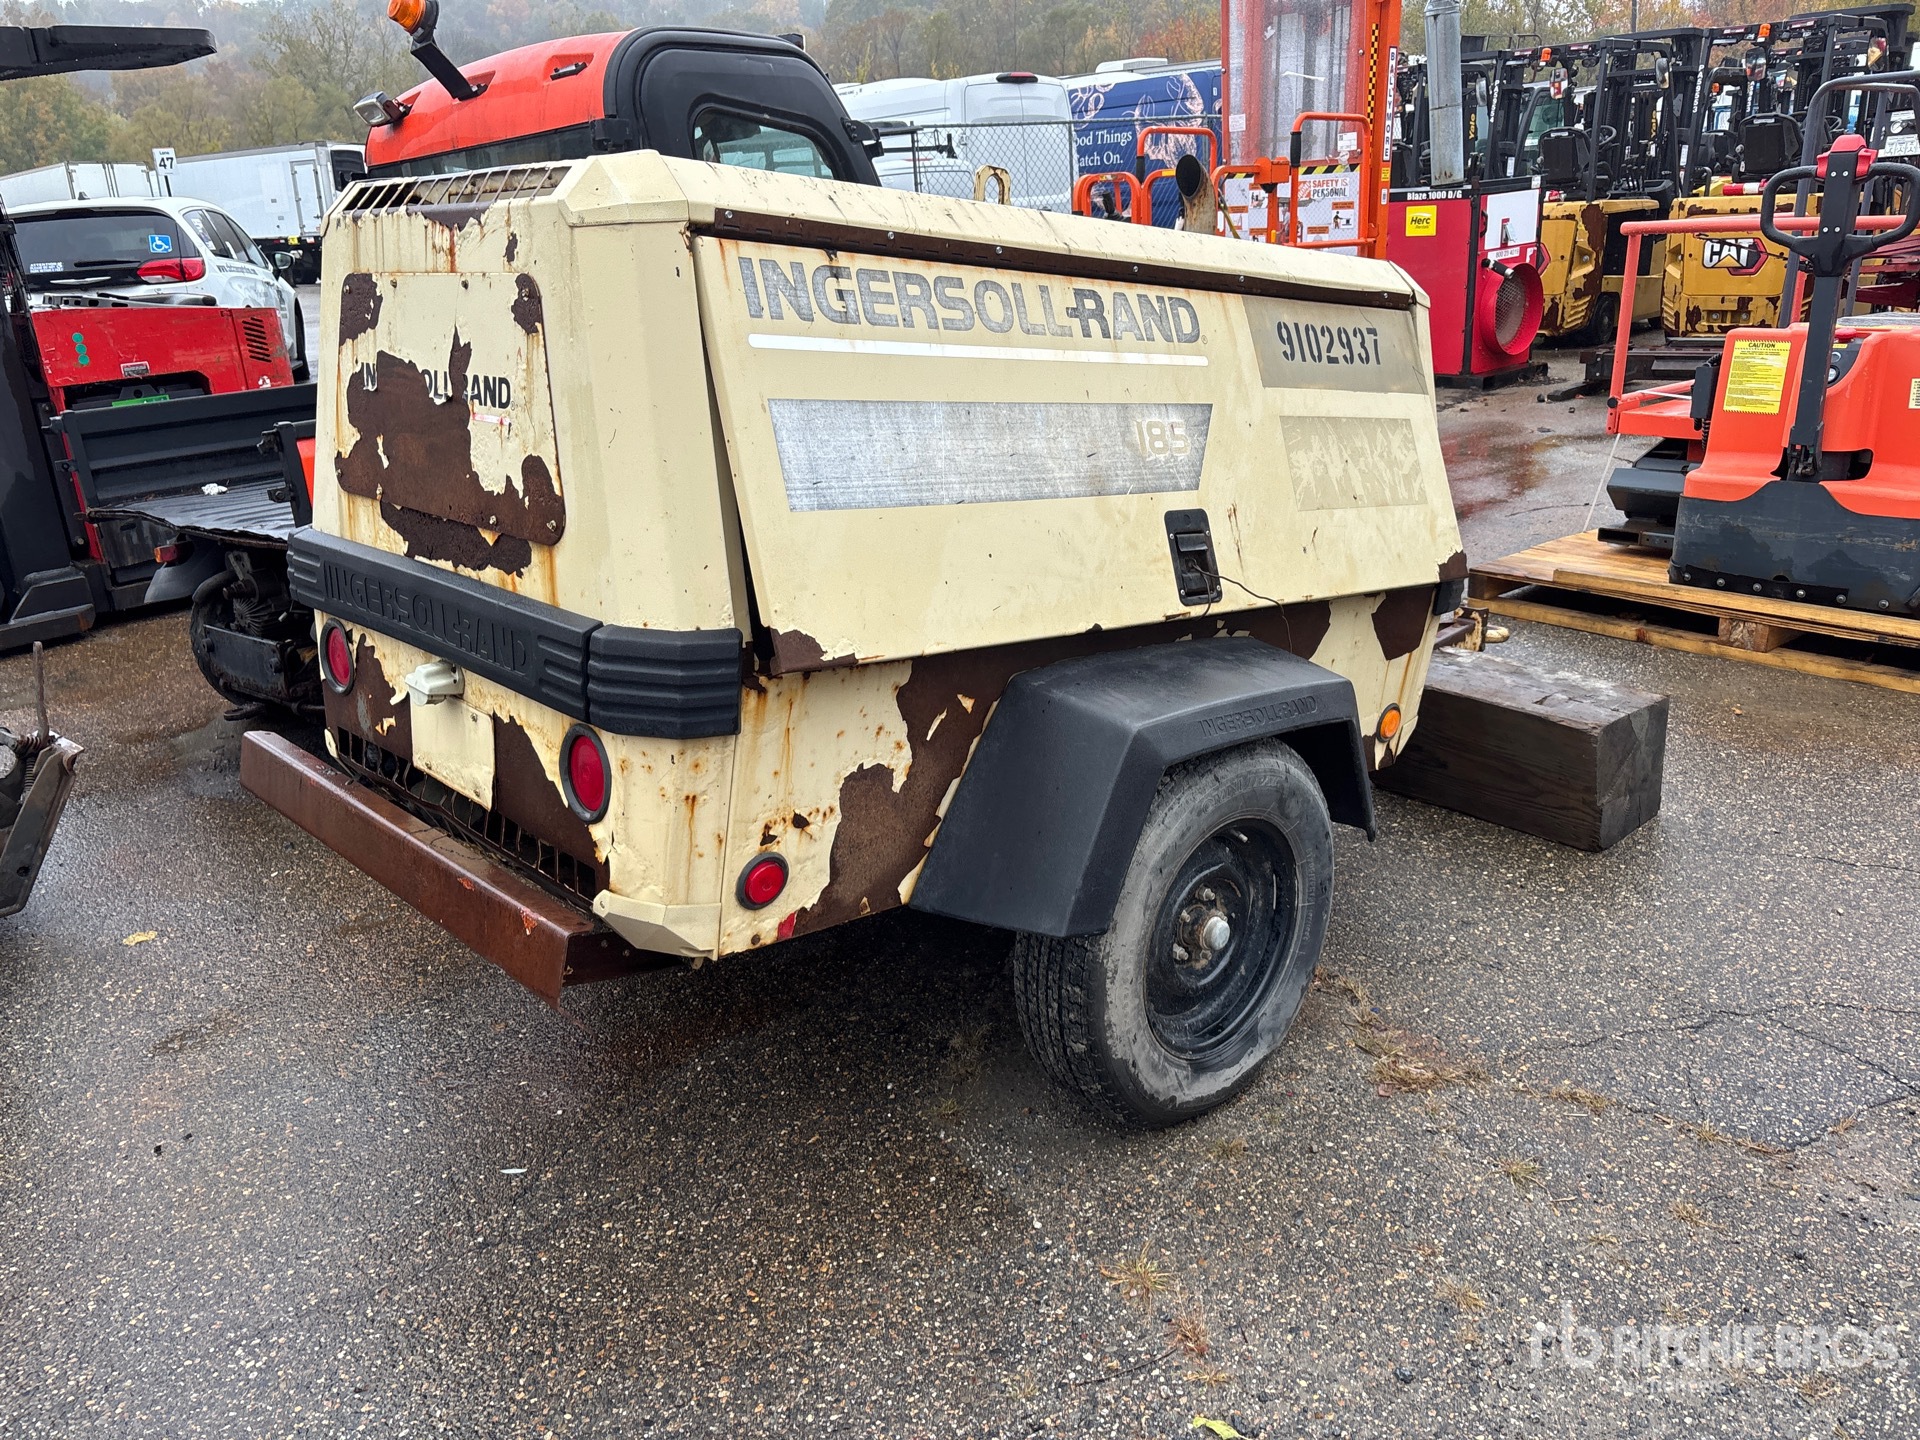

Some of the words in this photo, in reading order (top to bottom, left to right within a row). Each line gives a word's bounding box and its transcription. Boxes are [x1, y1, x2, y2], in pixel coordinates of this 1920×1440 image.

[1384, 52, 1396, 157] BALLYMORE
[1096, 130, 1132, 146] Things
[159, 157, 173, 169] 47
[1079, 152, 1100, 167] atch
[1103, 151, 1123, 164] On.
[1312, 179, 1338, 188] SAFETY
[1312, 187, 1347, 197] PERSONAL
[1407, 192, 1427, 200] Blaze
[1428, 191, 1447, 199] 1000
[1448, 190, 1462, 198] D/G
[1410, 216, 1431, 225] Herc
[1703, 239, 1754, 268] CAT
[1277, 321, 1381, 365] 9102937
[1133, 420, 1190, 458] 185
